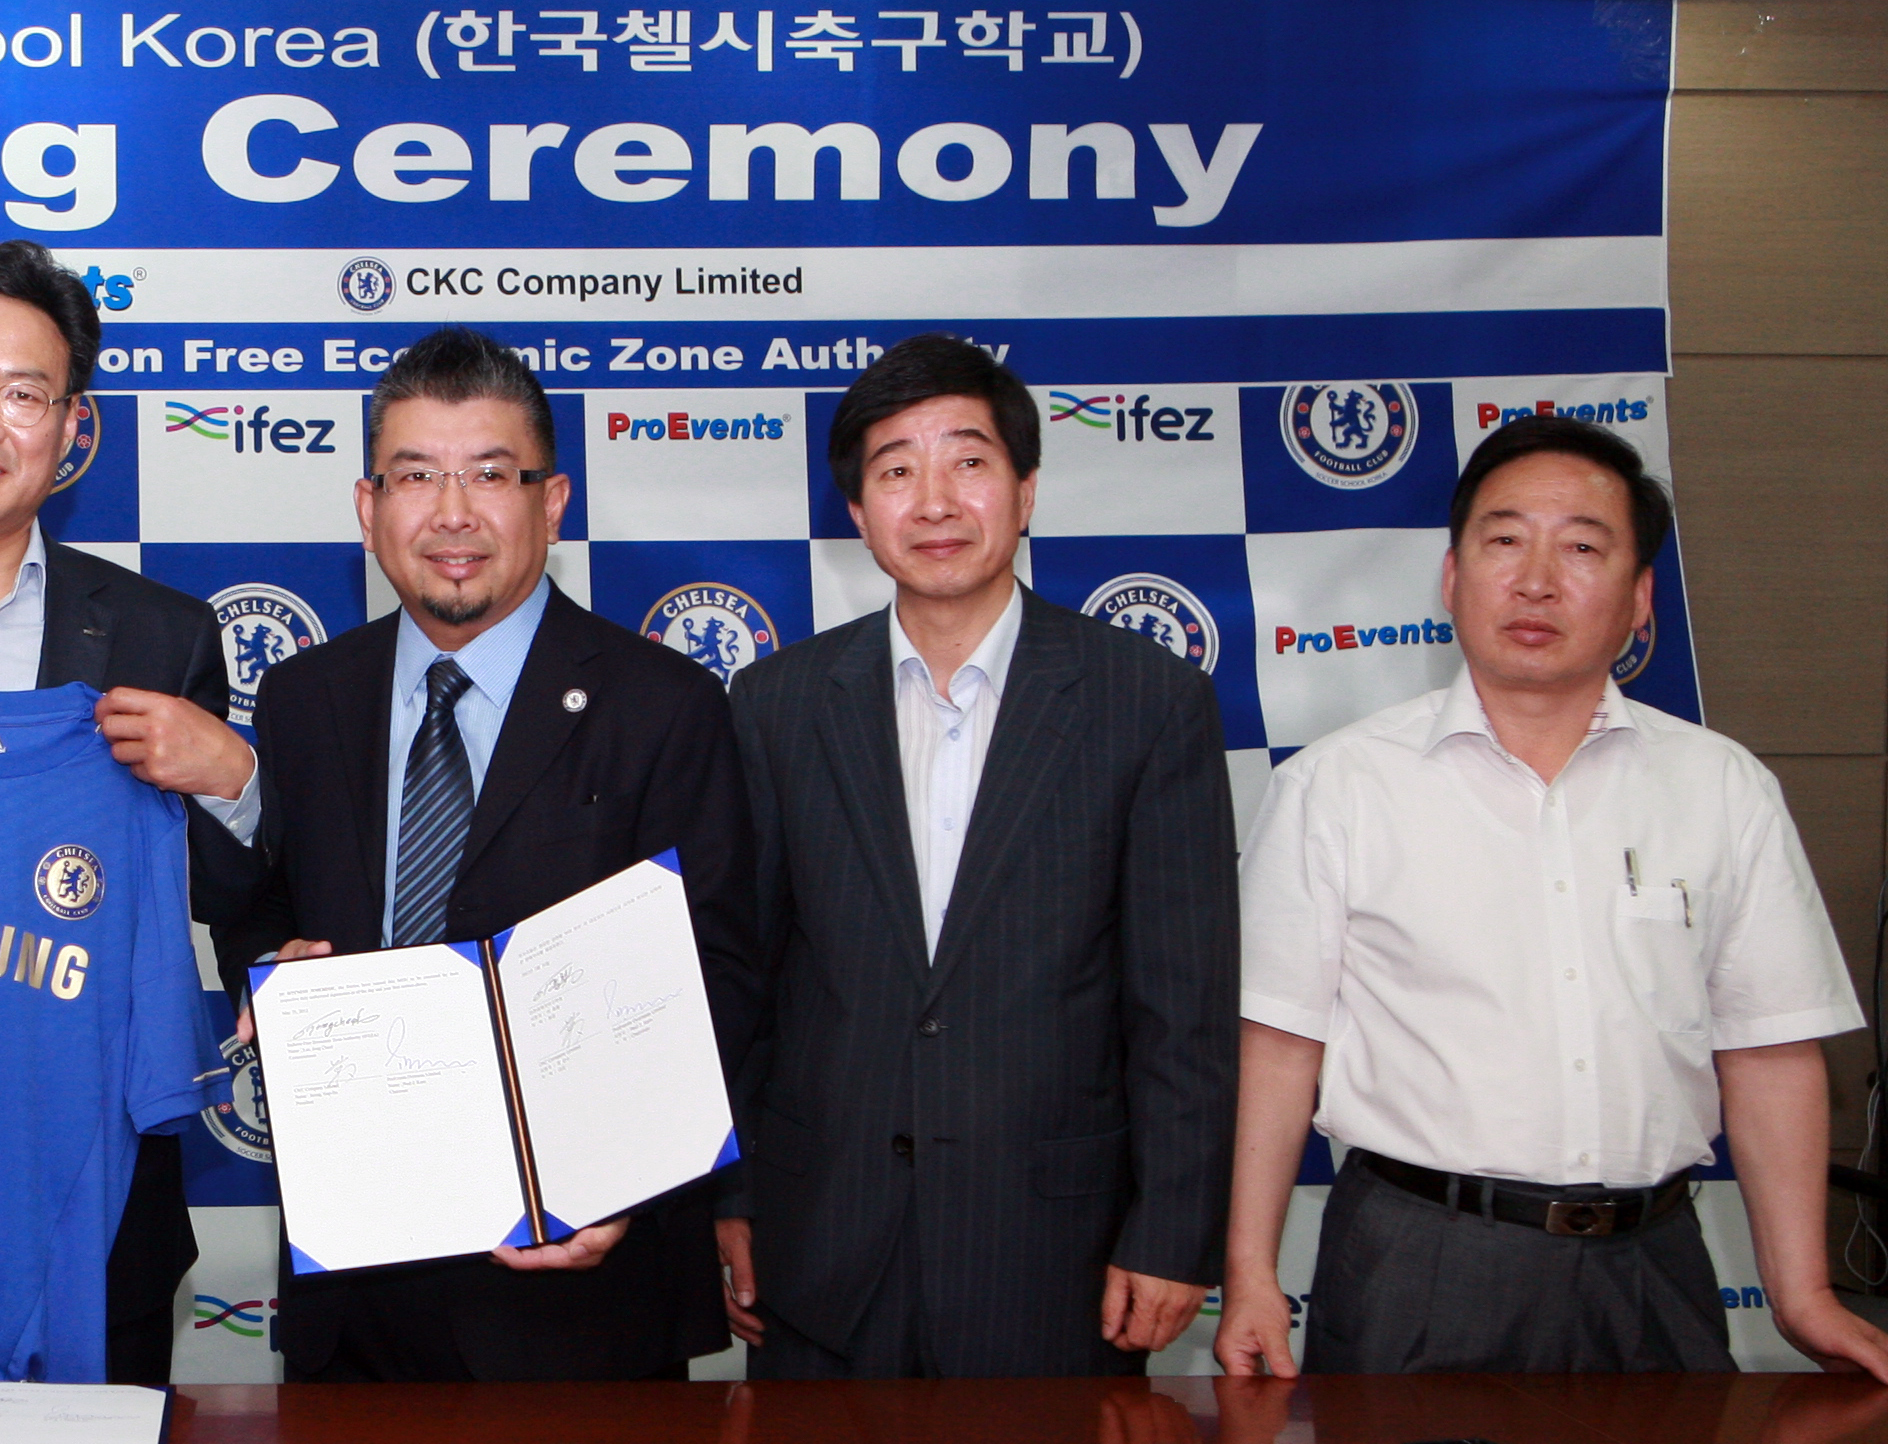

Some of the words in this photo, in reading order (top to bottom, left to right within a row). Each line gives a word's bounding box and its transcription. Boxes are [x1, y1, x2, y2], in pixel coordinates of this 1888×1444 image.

[121, 12, 380, 68] Korea
[415, 9, 1143, 79] (한국첼시축구학교)
[201, 93, 1264, 228] Ceremony
[406, 266, 484, 296] CKC
[496, 267, 663, 303] Company
[675, 266, 803, 295] Limited
[183, 339, 305, 373] Free
[323, 338, 592, 373] Ecmic
[608, 337, 744, 372] Zone
[233, 405, 337, 454] ifez
[1115, 393, 1215, 442] ifez
[1314, 450, 1362, 472] FOOTBALL
[1366, 450, 1389, 468] CLUB
[216, 599, 295, 626] CHELSEA
[662, 589, 749, 619] CHELSEA
[1104, 589, 1180, 614] CHELSEA
[1275, 618, 1453, 655] ProEvents
[235, 1126, 270, 1146] FOOTB
